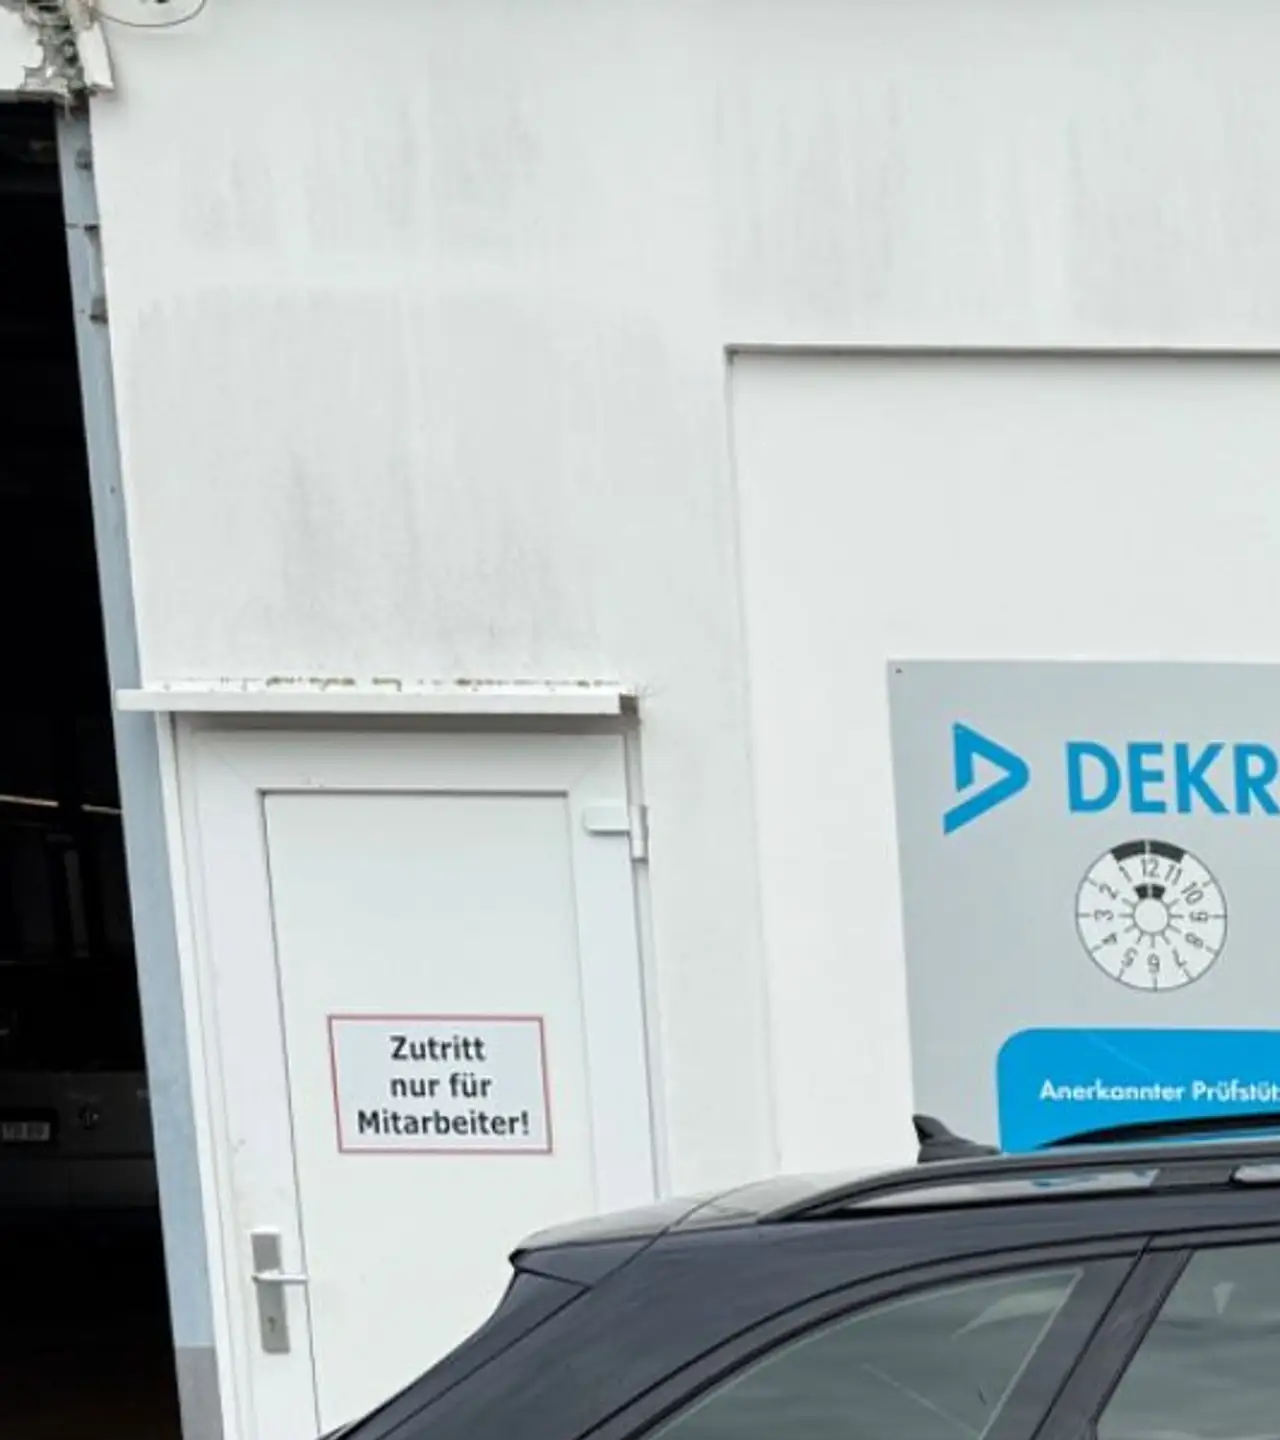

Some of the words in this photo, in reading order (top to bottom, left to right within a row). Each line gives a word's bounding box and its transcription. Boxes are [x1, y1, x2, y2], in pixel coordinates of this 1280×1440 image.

[1141, 858, 1160, 878] 12
[1164, 864, 1182, 885] 11
[1180, 881, 1204, 905] 10
[390, 1035, 486, 1061] Zutritt
[390, 1077, 440, 1098] nur
[449, 1072, 492, 1098] für
[1040, 1079, 1184, 1101] Anerkannter
[357, 1109, 530, 1136] Mitarbeiter!
